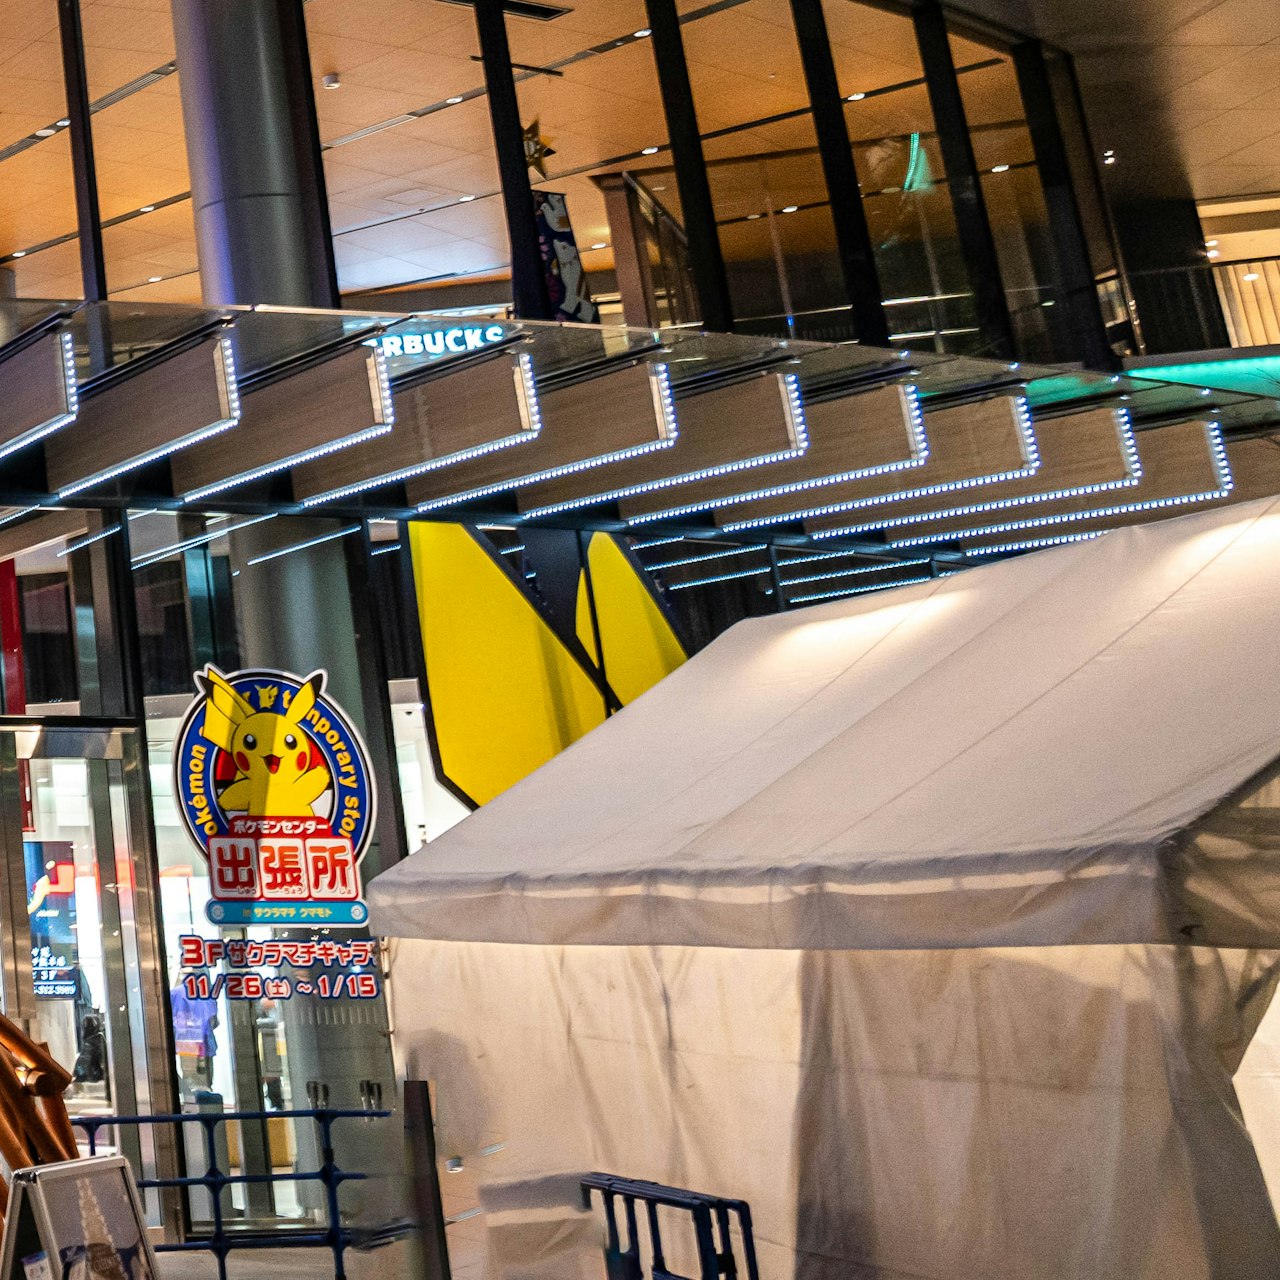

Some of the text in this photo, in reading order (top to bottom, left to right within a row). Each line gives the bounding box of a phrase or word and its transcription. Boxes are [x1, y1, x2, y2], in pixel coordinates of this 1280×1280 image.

[233, 820, 328, 835] ポケモンセンター
[216, 843, 349, 891] 出張所
